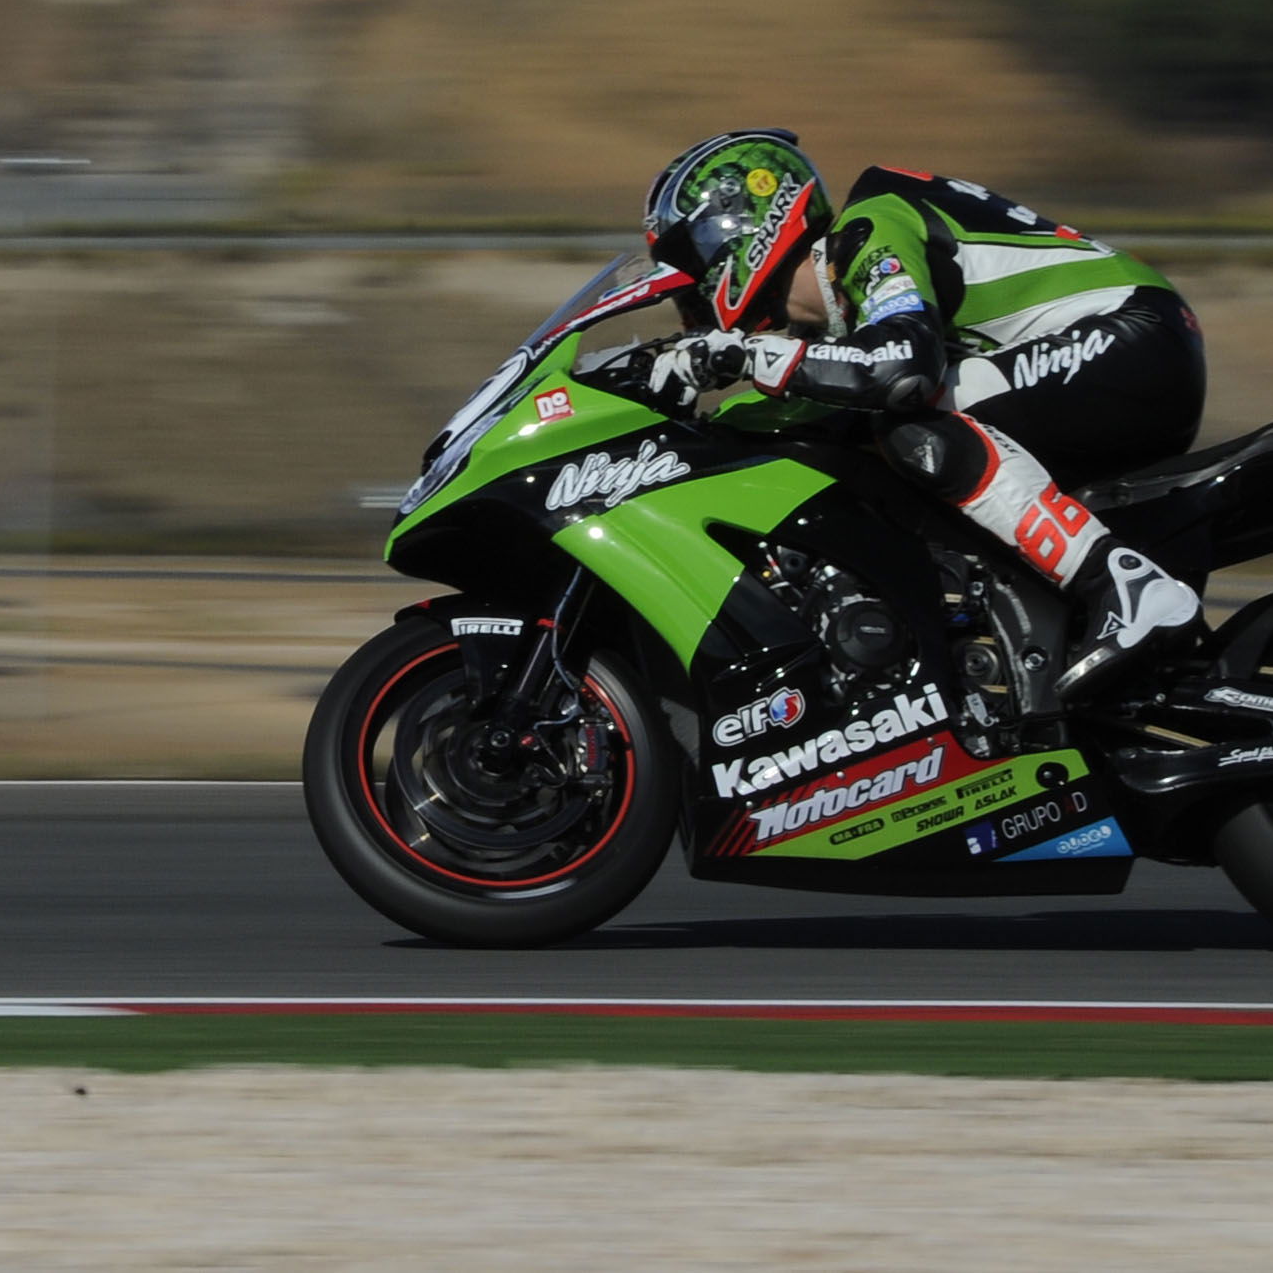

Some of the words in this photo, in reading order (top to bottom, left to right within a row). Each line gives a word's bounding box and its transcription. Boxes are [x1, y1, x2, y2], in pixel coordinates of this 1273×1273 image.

[745, 173, 801, 272] SHARK
[1013, 329, 1116, 390] Ninja
[545, 439, 691, 511] Ninja
[1014, 481, 1091, 576] 66
[451, 616, 524, 637] PIRELLI
[711, 683, 949, 799] Kawasaki
[713, 697, 770, 747] elf
[749, 742, 948, 843] Motocard
[916, 805, 965, 832] SHOWA
[974, 785, 1017, 811] ASLAK
[955, 768, 1013, 799] PIRELLI
[1001, 801, 1062, 839] GRUPO
